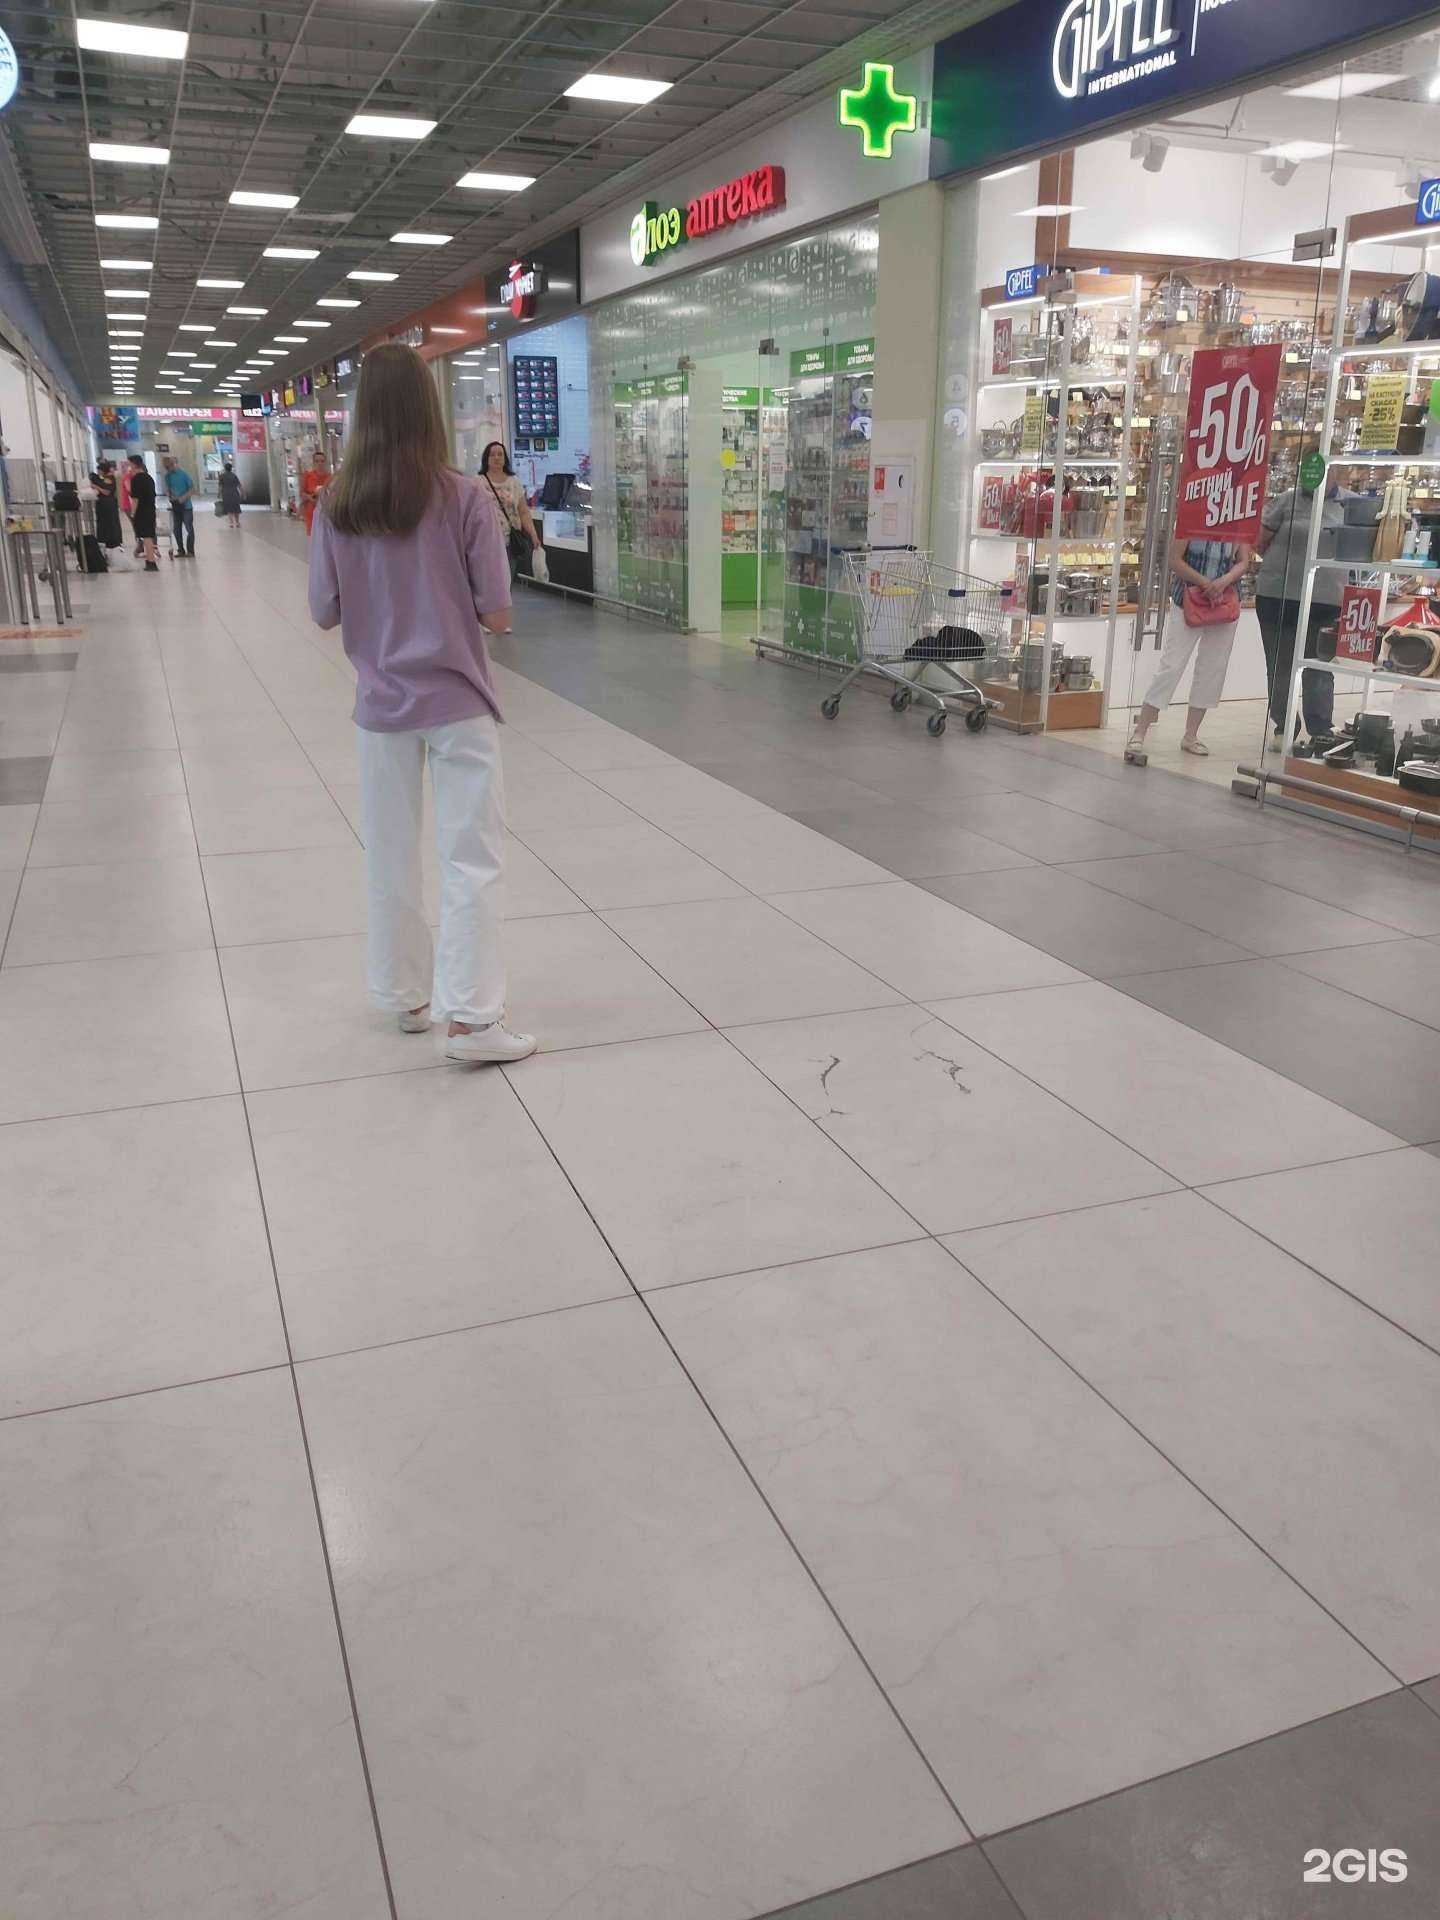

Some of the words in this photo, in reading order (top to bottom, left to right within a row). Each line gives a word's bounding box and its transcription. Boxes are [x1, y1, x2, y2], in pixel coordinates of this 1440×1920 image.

[1088, 51, 1177, 95] INTERNATIONAL
[686, 163, 776, 238] аптека
[1189, 373, 1266, 470] -50%
[1185, 467, 1233, 501] ЛЕТНИЙ
[1206, 481, 1260, 527] SALE
[1343, 598, 1375, 632] -50%
[1350, 638, 1373, 653] SALE
